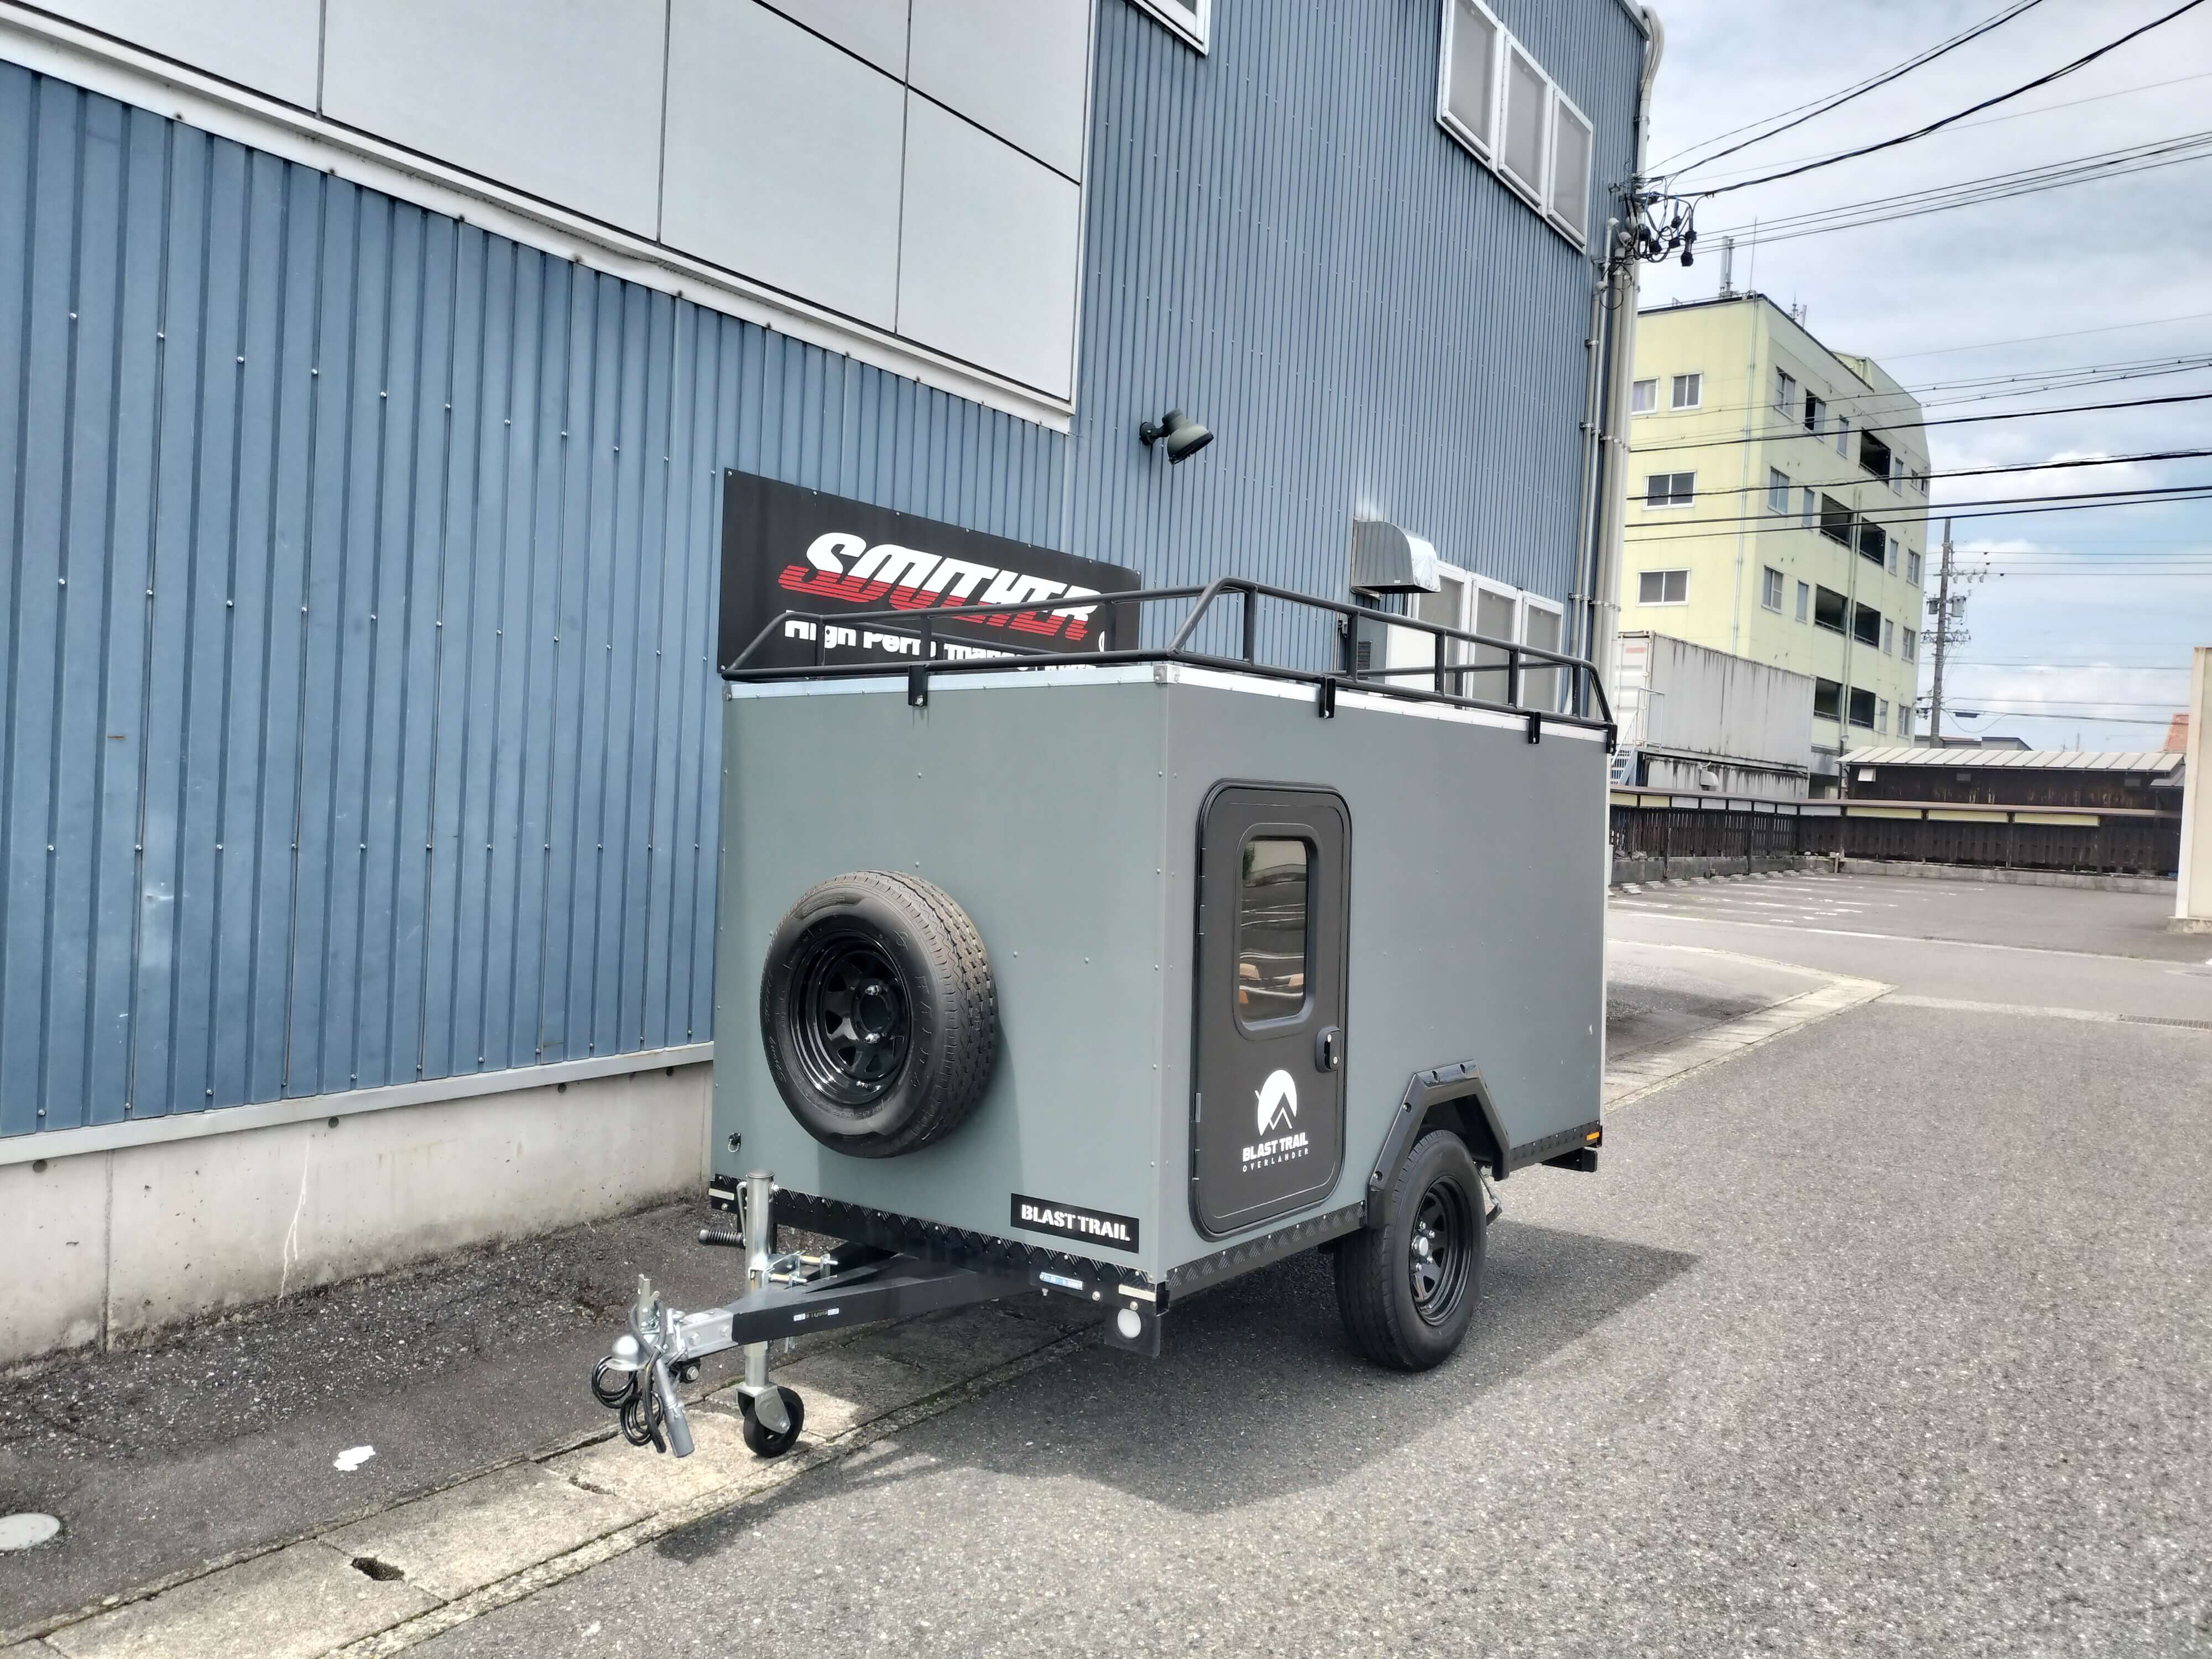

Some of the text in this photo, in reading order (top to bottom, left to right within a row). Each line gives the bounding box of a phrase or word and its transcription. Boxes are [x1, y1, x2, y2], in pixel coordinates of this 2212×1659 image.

[1242, 1147, 1308, 1172] OVERLANDER
[1243, 1132, 1309, 1162] BLAST TRAIL
[1021, 1204, 1130, 1241] BLAST TRAIL
